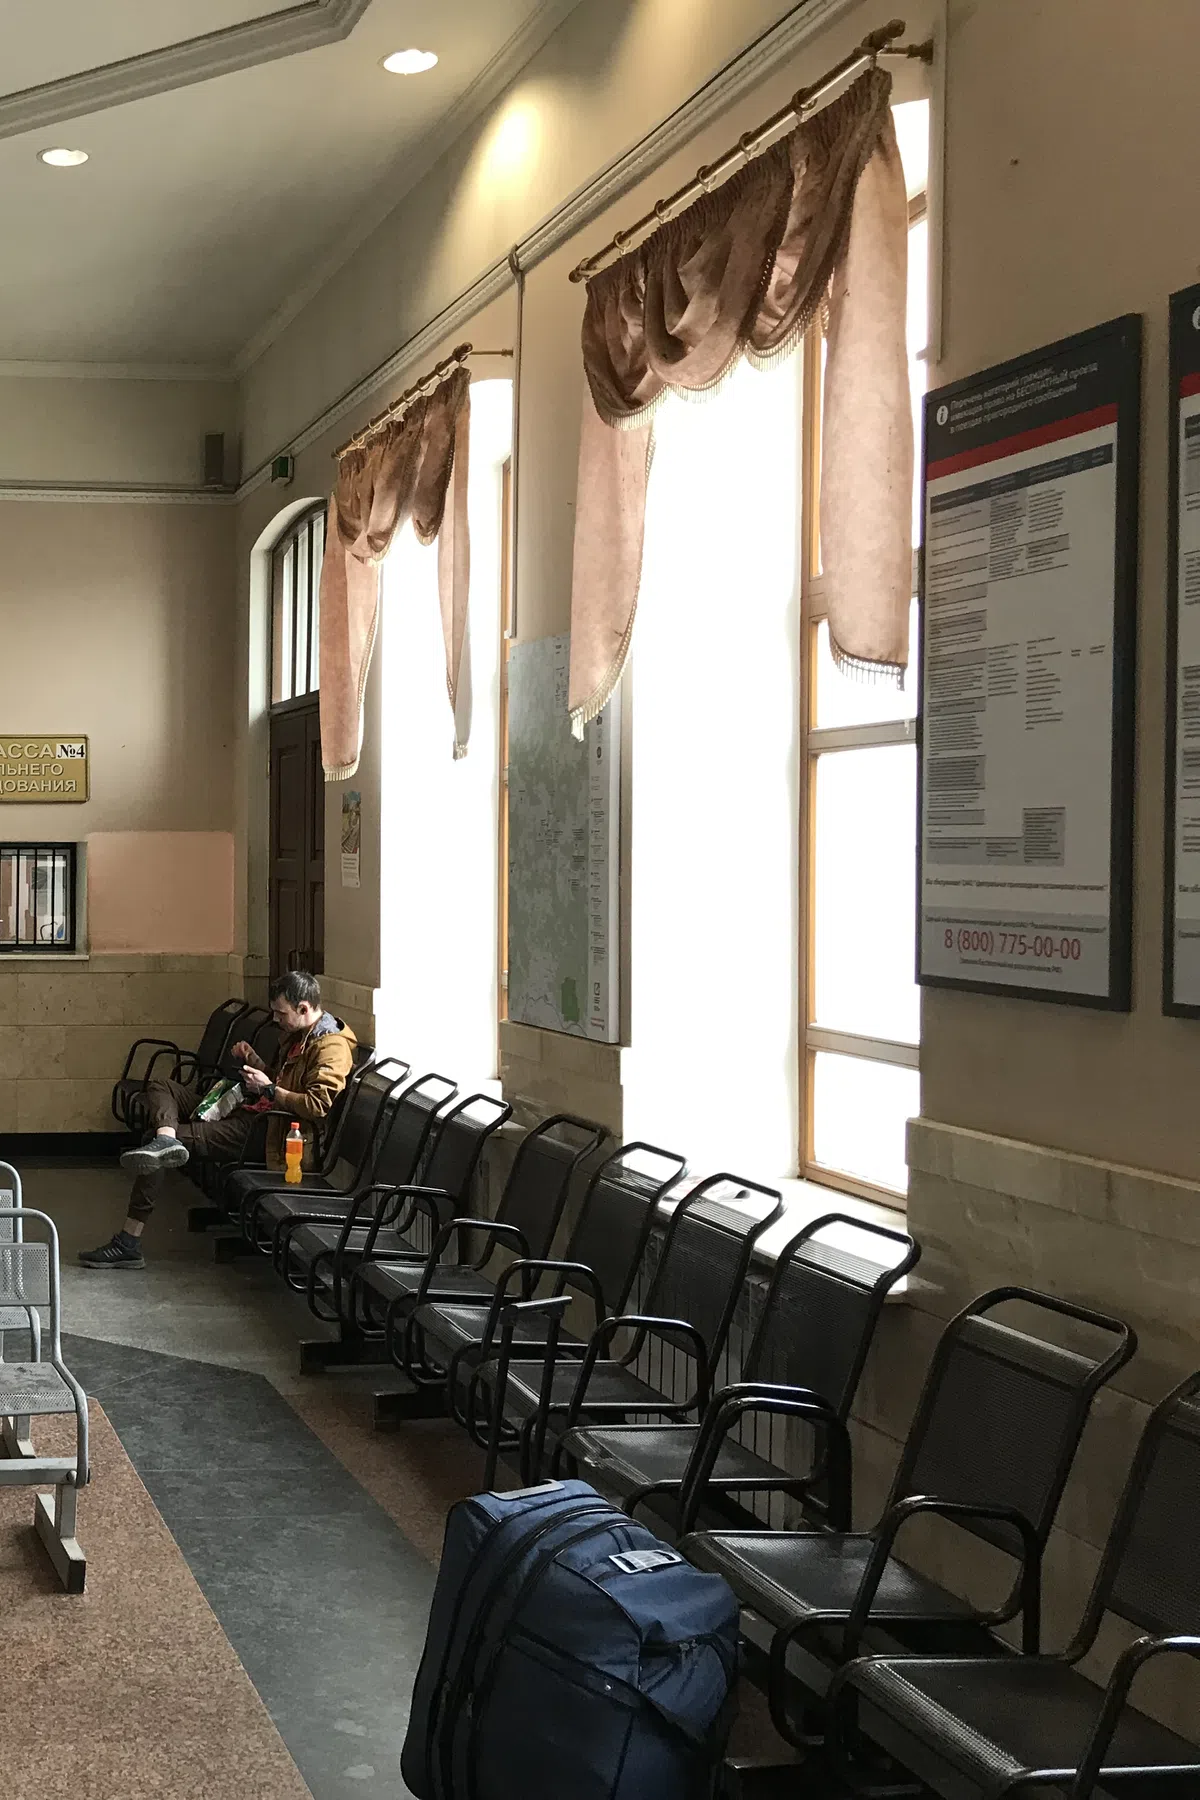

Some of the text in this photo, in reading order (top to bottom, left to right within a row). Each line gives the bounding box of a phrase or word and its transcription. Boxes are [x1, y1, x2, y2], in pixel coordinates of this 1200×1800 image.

[57, 744, 85, 758] №4
[944, 928, 1081, 960] 8 (800) 775-00-00
